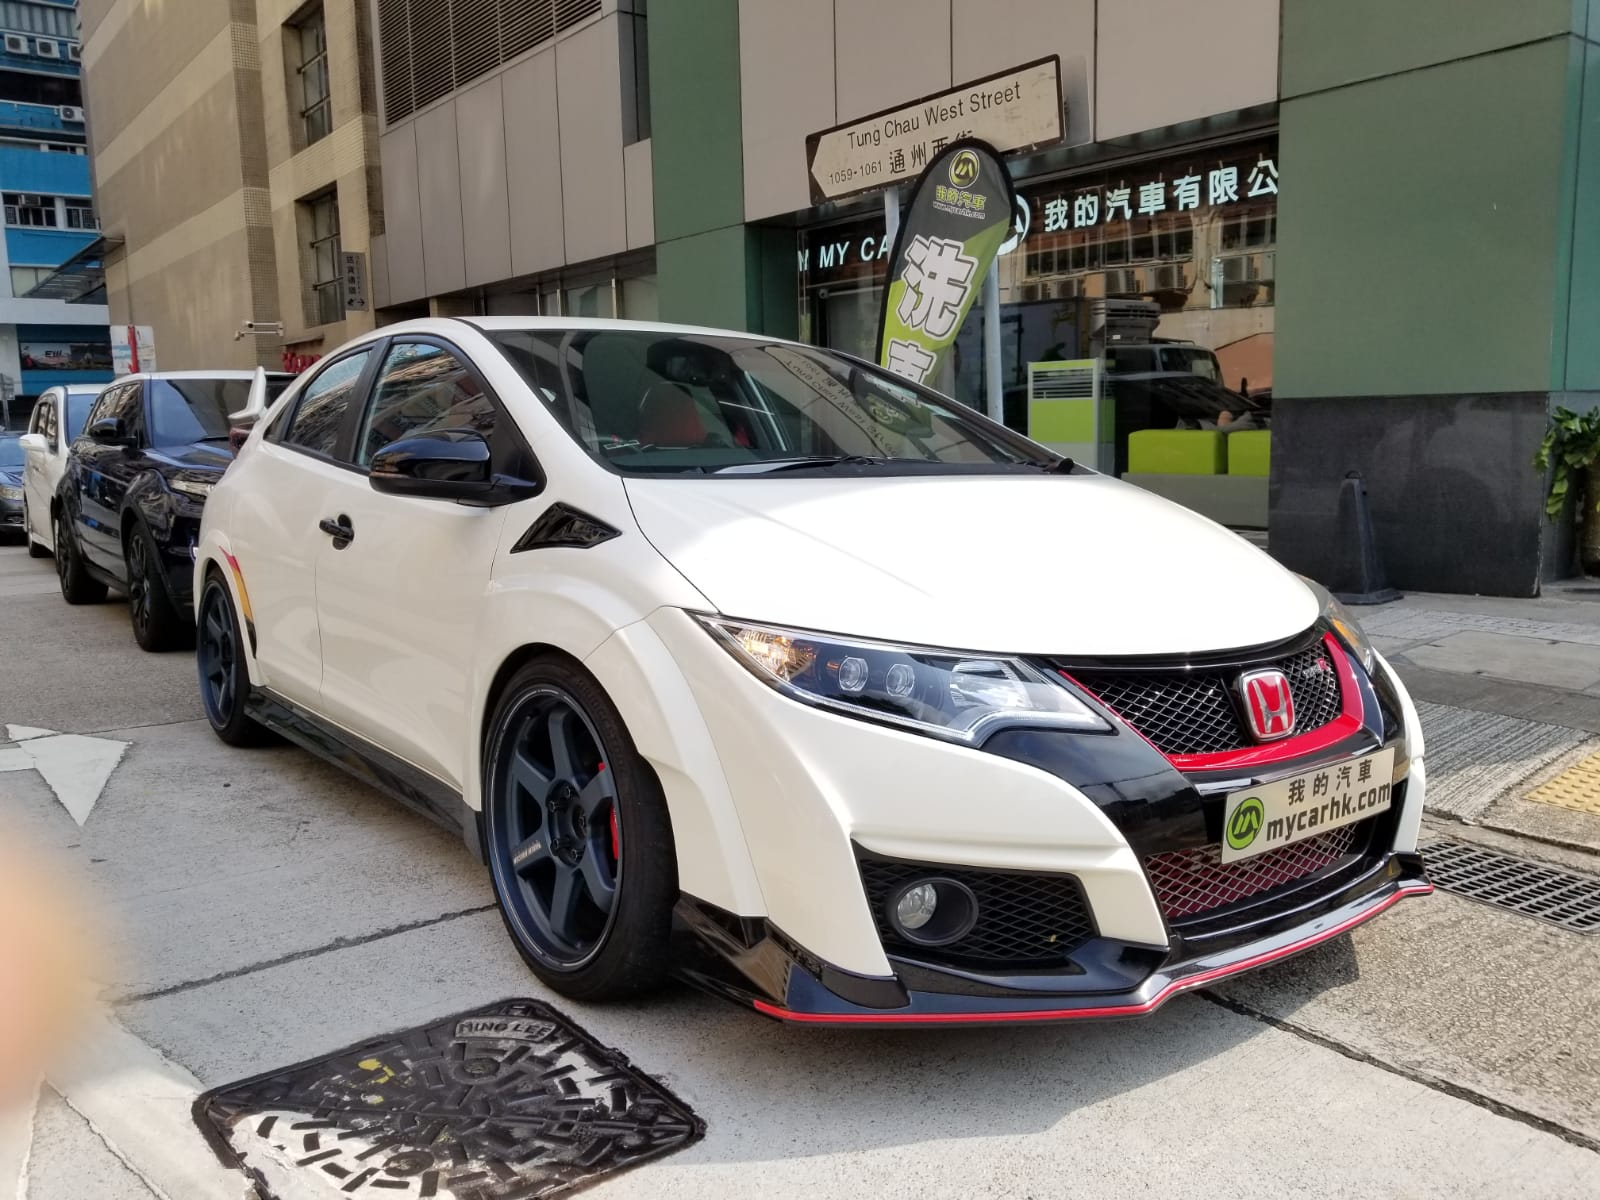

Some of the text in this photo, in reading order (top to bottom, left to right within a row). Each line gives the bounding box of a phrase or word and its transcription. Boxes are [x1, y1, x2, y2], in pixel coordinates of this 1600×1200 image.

[847, 81, 1021, 150] Tung Chau West Street
[935, 184, 986, 211] 我的汽車
[1044, 159, 1279, 232] 我的汽車有限公
[819, 241, 850, 269] MY
[1288, 759, 1373, 807] 我的汽車
[1266, 782, 1391, 842] mycarhk.com
